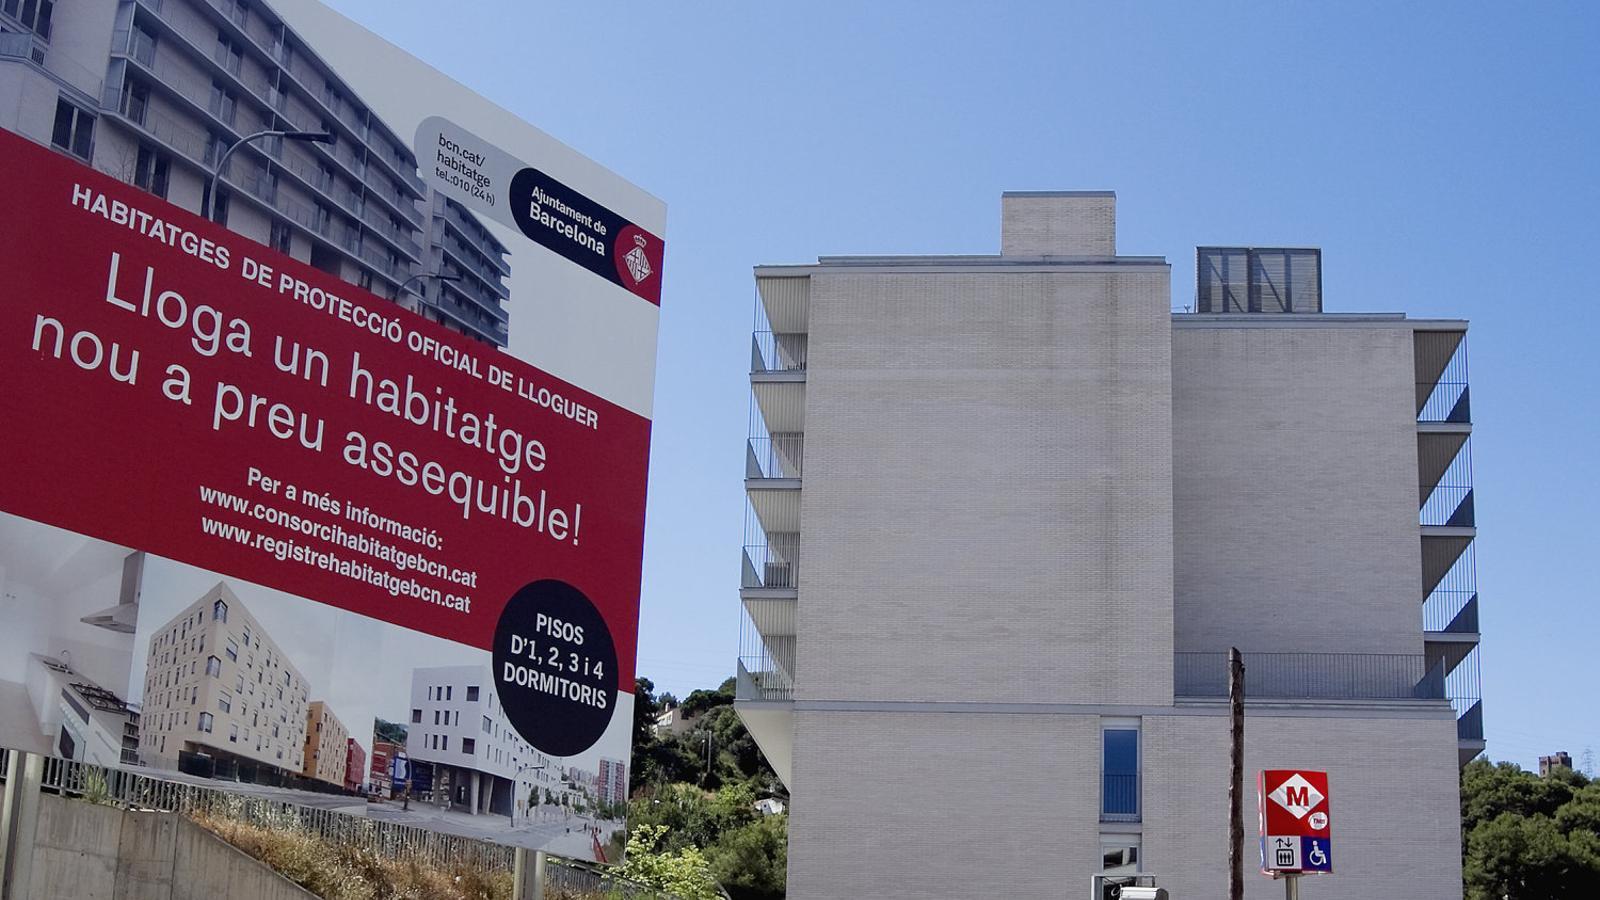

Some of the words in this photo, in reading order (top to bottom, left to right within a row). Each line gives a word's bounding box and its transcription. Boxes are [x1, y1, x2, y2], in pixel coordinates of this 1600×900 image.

[437, 149, 491, 188] habitatge
[438, 133, 486, 167] bcn.cat/
[435, 167, 470, 192] tel.:010
[471, 185, 485, 201] (24
[485, 193, 496, 207] h)
[531, 186, 592, 228] Ajuntament
[593, 221, 607, 236] de
[529, 201, 606, 257] Barcelona
[71, 183, 230, 269] HABITATGES
[241, 256, 273, 289] DE
[278, 273, 403, 343] PROTECCIÓ
[407, 330, 483, 380] OFICIAL
[487, 364, 514, 392] DE
[517, 378, 599, 430] LLOGUER
[105, 251, 253, 358] Lloga
[273, 335, 330, 388] un
[349, 351, 548, 475] habitatge
[31, 313, 140, 386] nou
[161, 362, 192, 406] a
[212, 381, 325, 453] preu
[342, 430, 582, 546] assequible!
[247, 466, 281, 495] Per
[285, 484, 297, 501] a
[302, 491, 341, 515] més
[345, 501, 444, 551] informació:
[199, 485, 478, 589] www.consorcihabitatgebcn.cat
[201, 516, 471, 614] www.registrehabitatgebcn.cat
[536, 613, 584, 645] PISOS
[503, 662, 607, 709] DORMITORIS
[547, 646, 564, 672] 2,
[568, 652, 579, 673] 3
[583, 656, 590, 676] i
[592, 660, 604, 680] 4
[1286, 786, 1309, 807] M
